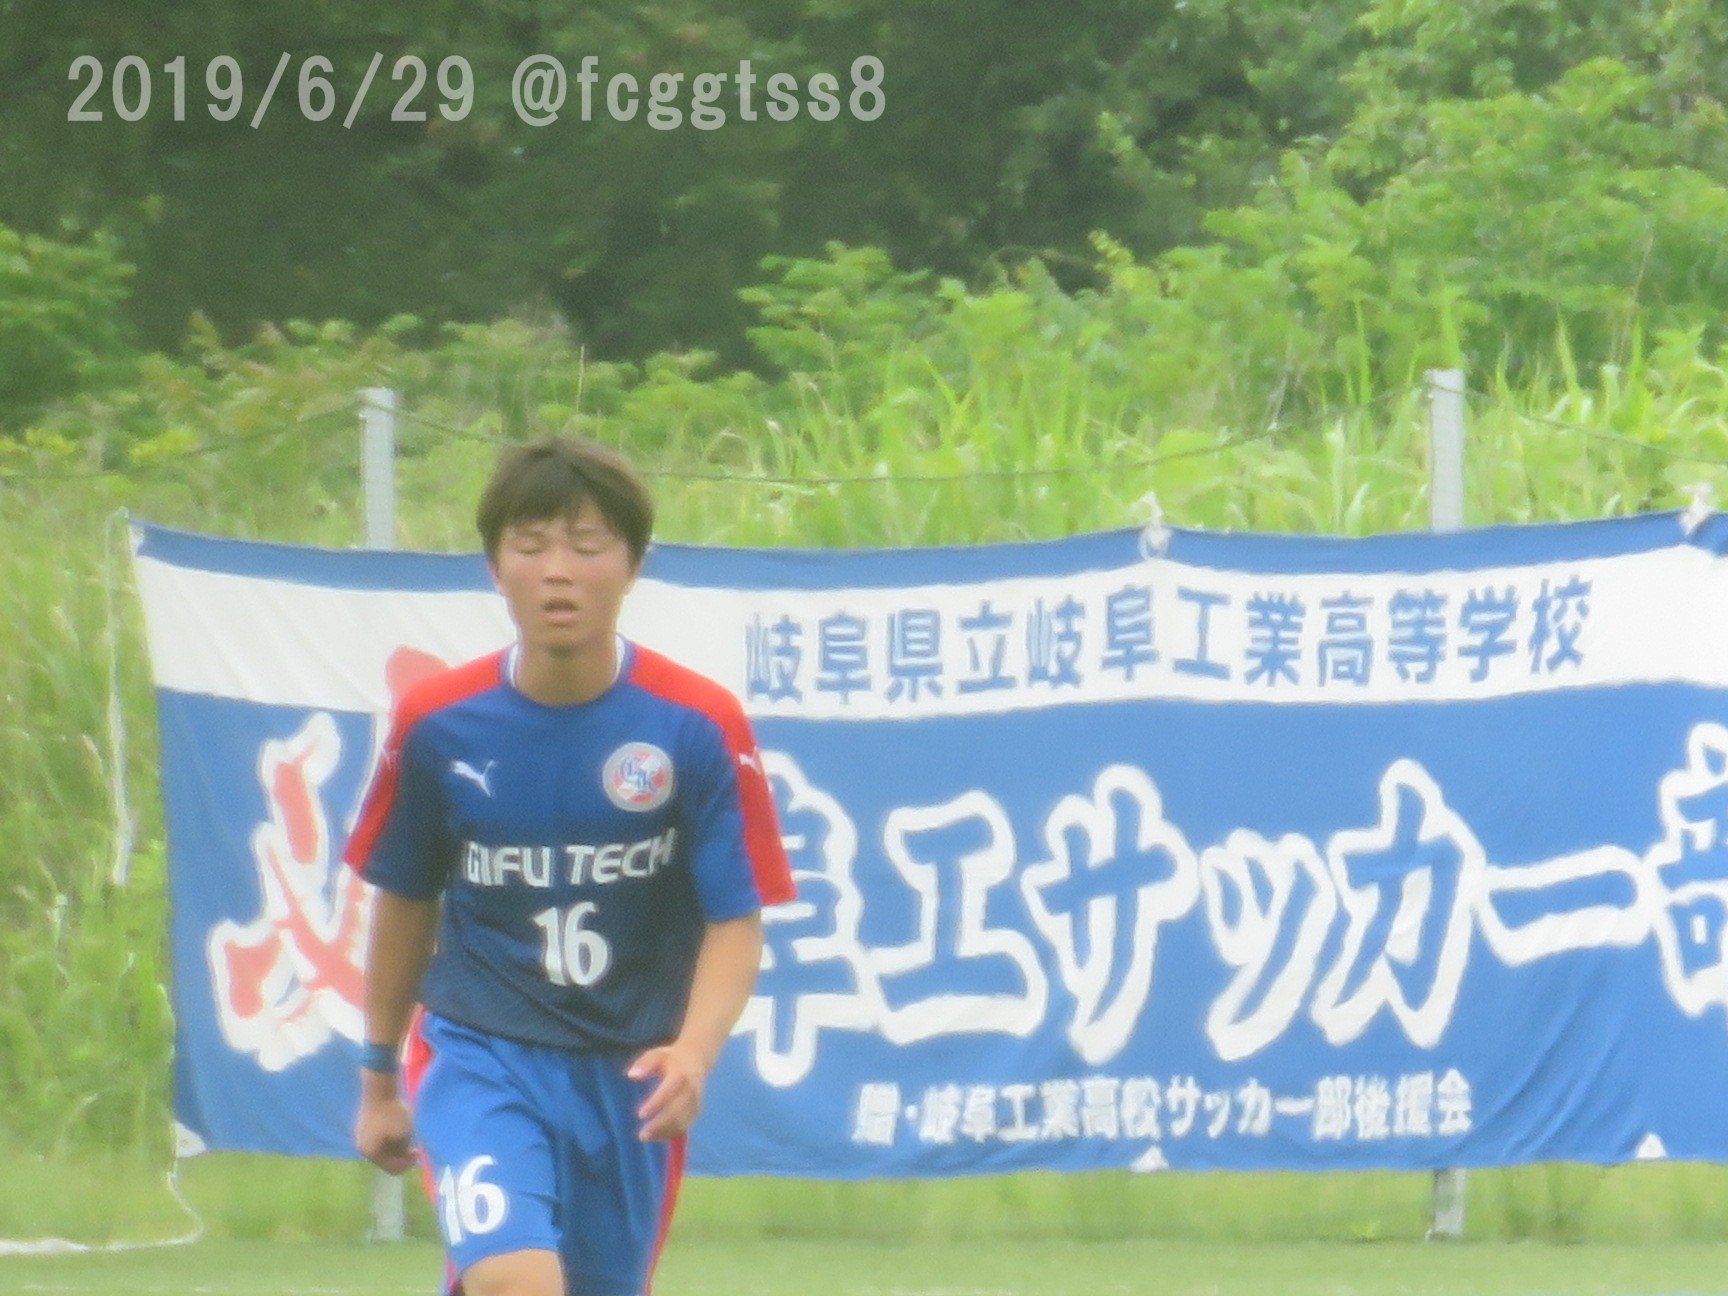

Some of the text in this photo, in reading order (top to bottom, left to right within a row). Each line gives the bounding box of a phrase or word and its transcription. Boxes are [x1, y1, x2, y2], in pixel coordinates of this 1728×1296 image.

[743, 575, 1593, 704] 岐阜県立岐阜工業高等学校
[464, 827, 676, 888] GIFU TECH
[532, 901, 608, 986] 16
[439, 1155, 507, 1247] 16
